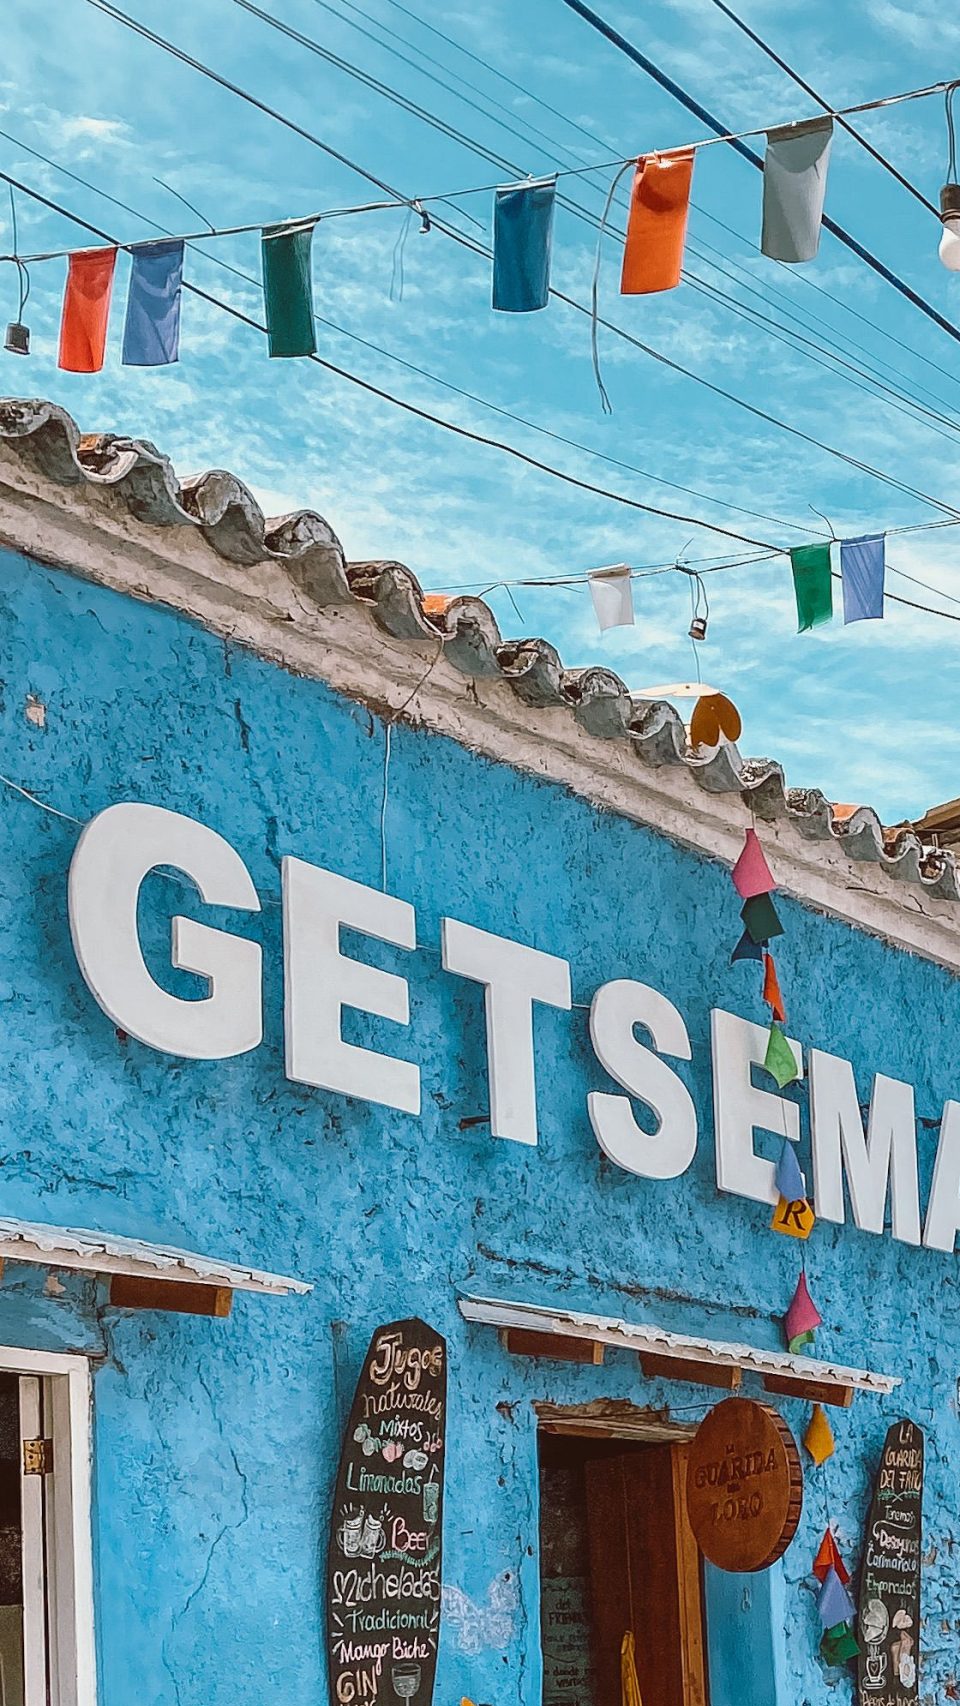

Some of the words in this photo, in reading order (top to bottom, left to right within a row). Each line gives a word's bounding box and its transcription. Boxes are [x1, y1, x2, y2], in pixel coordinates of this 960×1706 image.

[369, 1332, 443, 1390] Jugos
[899, 1423, 913, 1444] LA
[346, 1462, 423, 1495] Limonadas
[694, 1447, 779, 1489] GUARIDA
[391, 1517, 431, 1551] Beer
[332, 1562, 440, 1607] Micheladas
[345, 1608, 431, 1633] Tradicional
[339, 1640, 391, 1676] Mango
[392, 1636, 430, 1660] Biche
[336, 1665, 378, 1703] GIN
